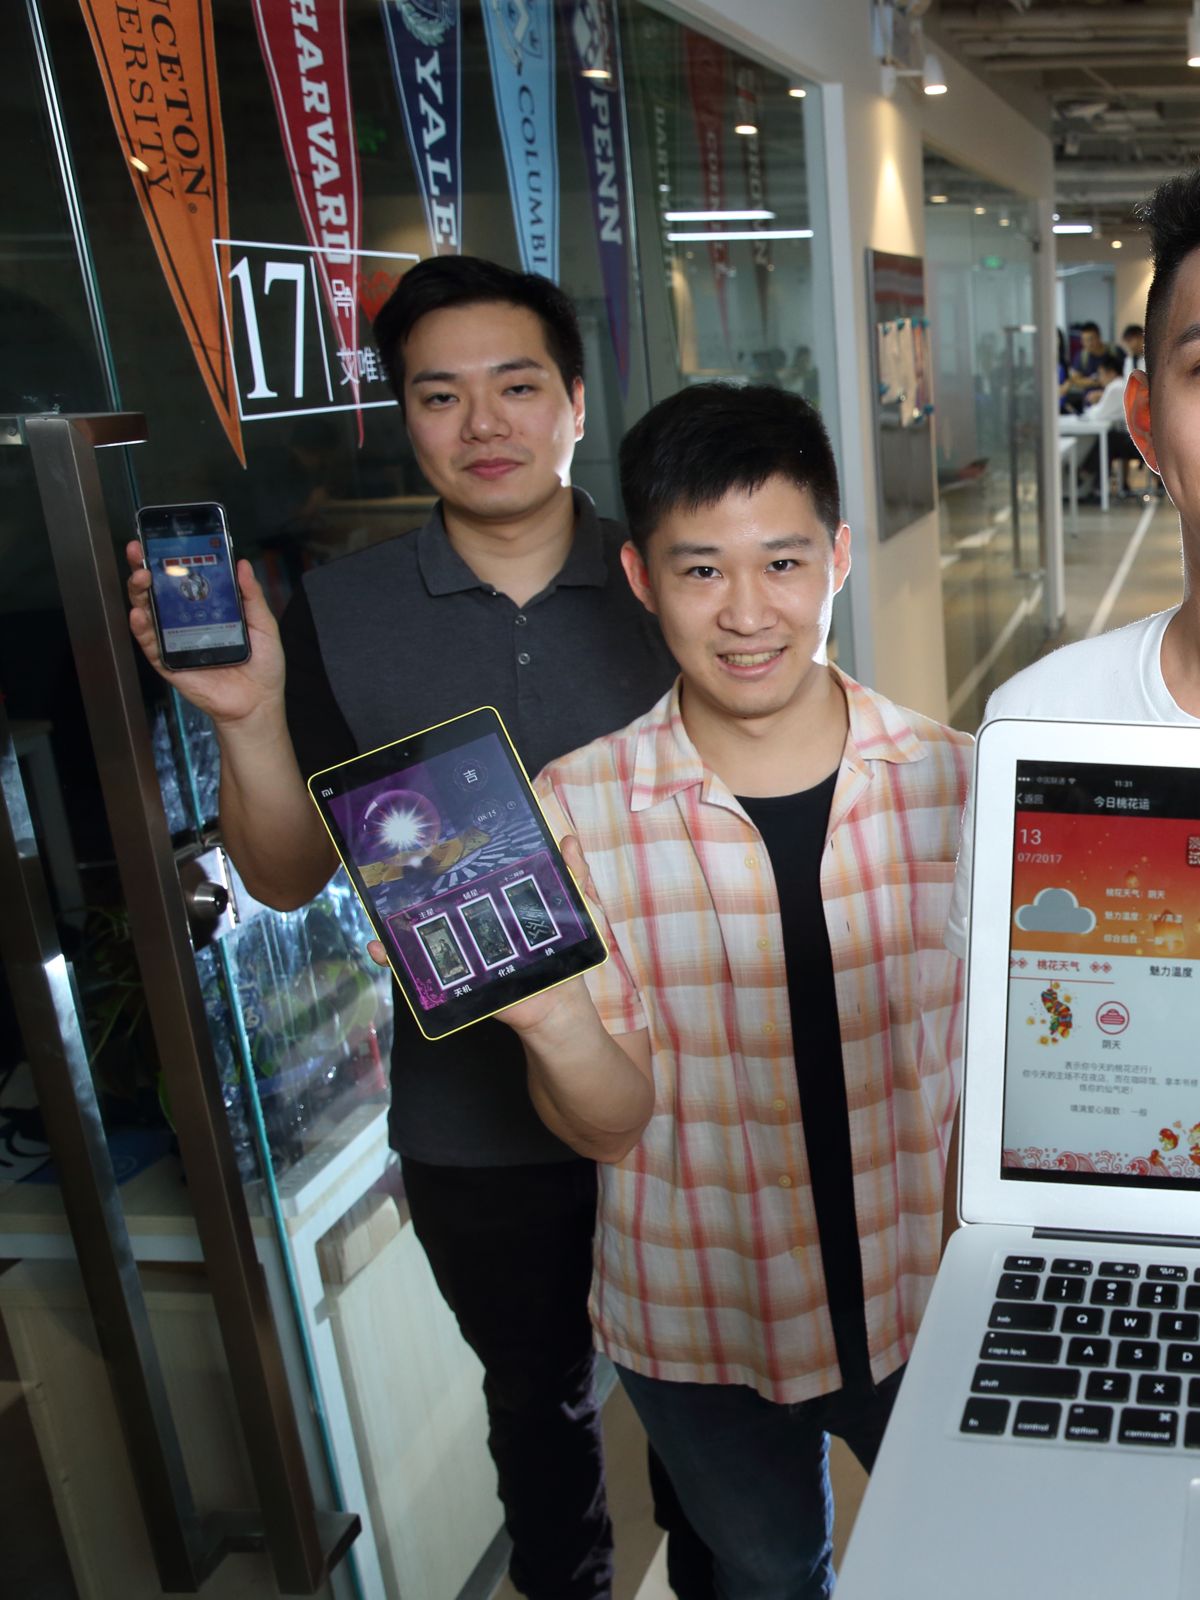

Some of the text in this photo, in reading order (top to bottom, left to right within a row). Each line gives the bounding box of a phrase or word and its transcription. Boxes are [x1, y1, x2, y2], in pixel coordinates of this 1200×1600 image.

[150, 0, 211, 199] CETON
[290, 0, 351, 264] HARVARD
[414, 51, 457, 246] YALE
[590, 89, 622, 244] PENN
[517, 84, 547, 264] COLUMBI
[228, 256, 305, 399] 17
[462, 769, 479, 784] 吉
[1020, 829, 1042, 846] 13
[1018, 852, 1063, 864] 07/2017
[454, 983, 473, 998] 天机
[1150, 965, 1193, 979] 魅力温度
